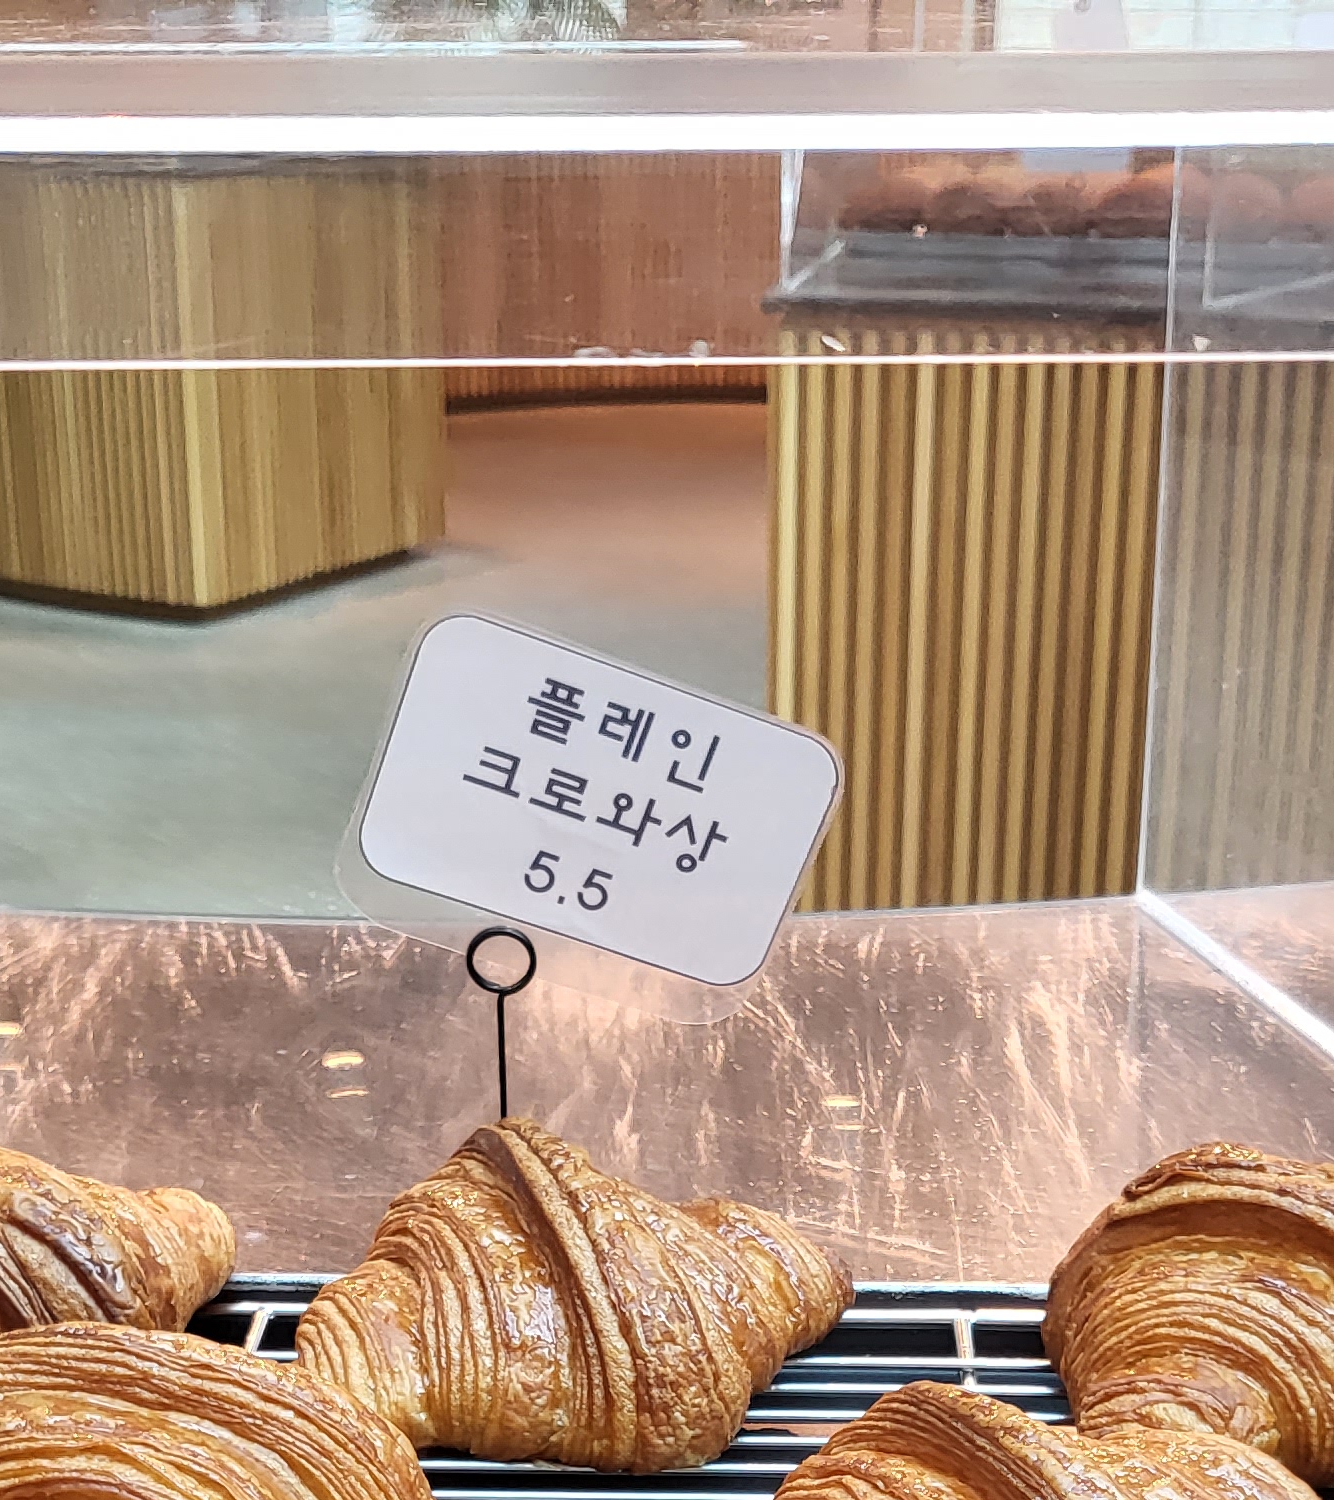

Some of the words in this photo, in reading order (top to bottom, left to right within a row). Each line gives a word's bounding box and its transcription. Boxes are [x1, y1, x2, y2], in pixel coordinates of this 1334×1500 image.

[527, 676, 721, 795] 플레인
[462, 745, 729, 873] 크로와상
[523, 849, 615, 911] 5.5
